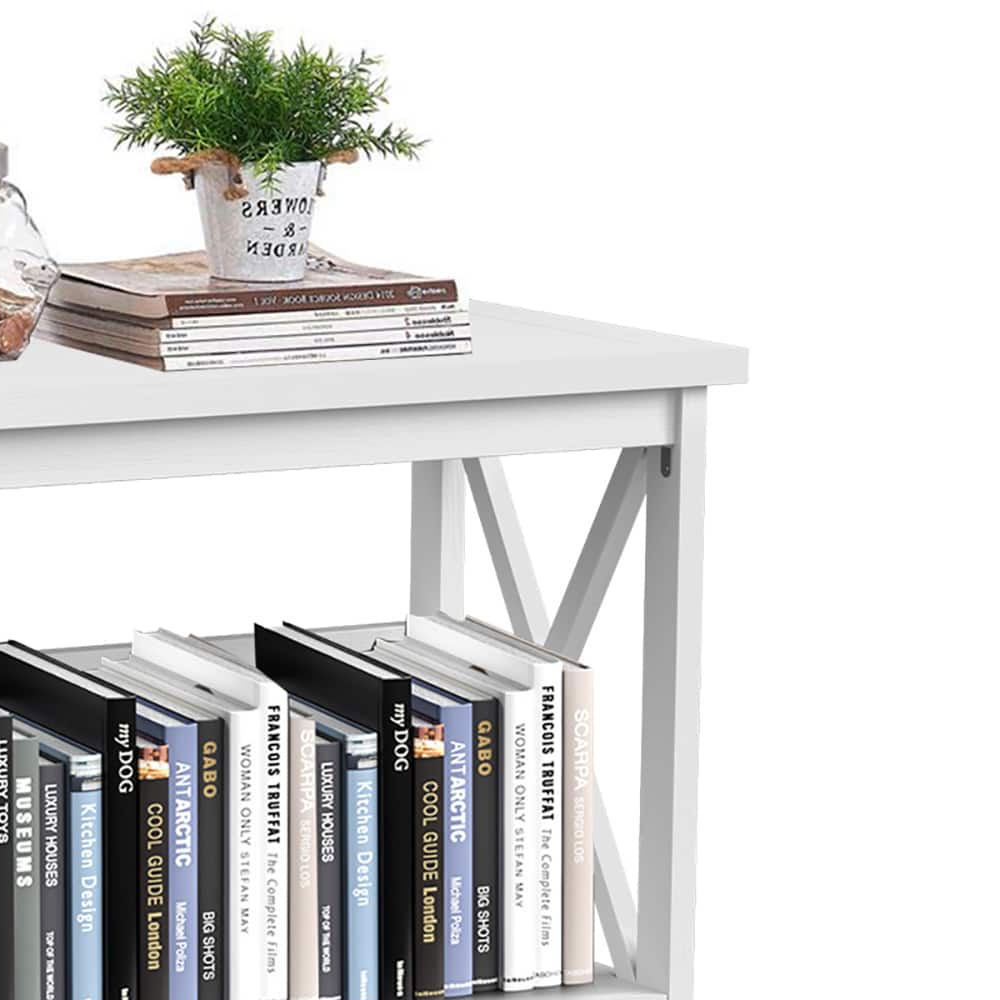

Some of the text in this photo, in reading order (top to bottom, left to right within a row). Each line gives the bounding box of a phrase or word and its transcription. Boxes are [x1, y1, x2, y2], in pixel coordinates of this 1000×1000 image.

[114, 723, 134, 794] my DOG
[203, 741, 217, 798] GABO
[267, 705, 280, 776] FRANCOIS
[300, 728, 315, 814] SCARPA
[389, 703, 409, 772] my DOG
[477, 720, 492, 776] GABO
[514, 722, 526, 823] WOMAN ONLY
[574, 708, 589, 791] SCARPA
[15, 777, 33, 888] MUSEUMS
[175, 762, 192, 868] ANTARCTIC
[240, 744, 252, 845] WOMAN ONLY
[267, 782, 280, 844] TRUFFAT
[321, 762, 334, 863] LUXURY HOUSES
[450, 741, 466, 843] ANTARCTIC
[539, 685, 554, 947] FRANCOIS TRUFFAT The Complete Films
[44, 783, 58, 888] LUXURY HOUSES
[76, 803, 97, 933] Kitchen Design
[267, 852, 278, 870] The
[352, 780, 373, 907] Kitchen Design
[423, 780, 438, 943] COOL GUIDE London
[514, 827, 524, 908] STEFAN MAY
[147, 803, 164, 970] COOL GUIDE London
[240, 851, 250, 934] STEFAN MAY
[265, 878, 278, 937] Complete
[477, 885, 490, 953] BIG SHOTS
[202, 911, 216, 981] BIG SHOTS
